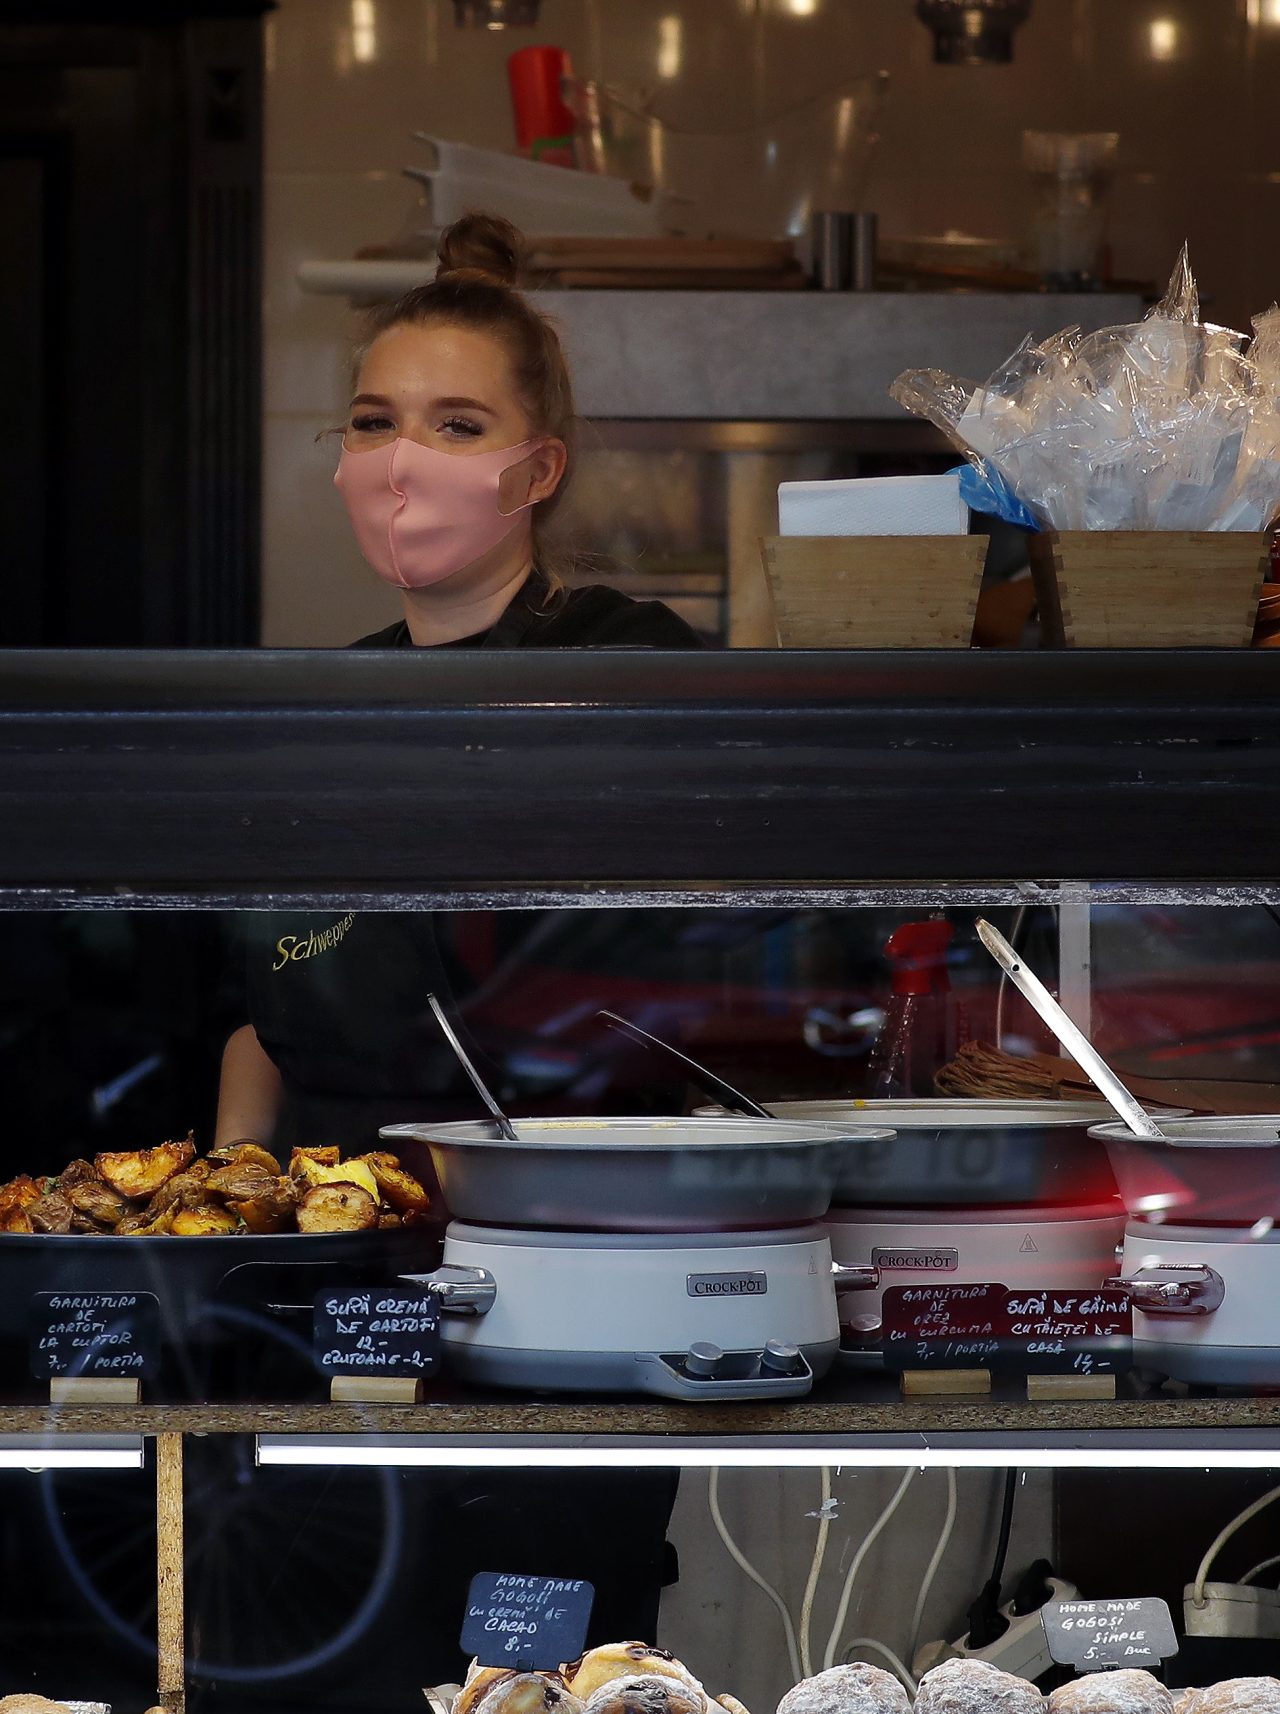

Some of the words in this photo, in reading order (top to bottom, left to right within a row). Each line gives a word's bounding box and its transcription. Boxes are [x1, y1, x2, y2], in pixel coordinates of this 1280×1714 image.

[273, 912, 356, 971] Schweppes
[930, 1299, 948, 1312] DE
[1053, 1299, 1078, 1314] DE
[75, 1309, 95, 1322] DE
[336, 1318, 363, 1334] DE
[368, 1316, 440, 1333] CARTOFI
[1094, 1323, 1120, 1336] DE
[39, 1336, 59, 1349] LA
[495, 1574, 539, 1589] HOME
[1059, 1603, 1097, 1614] HOME
[1106, 1600, 1142, 1613] MADE
[484, 1617, 538, 1634] CACAO
